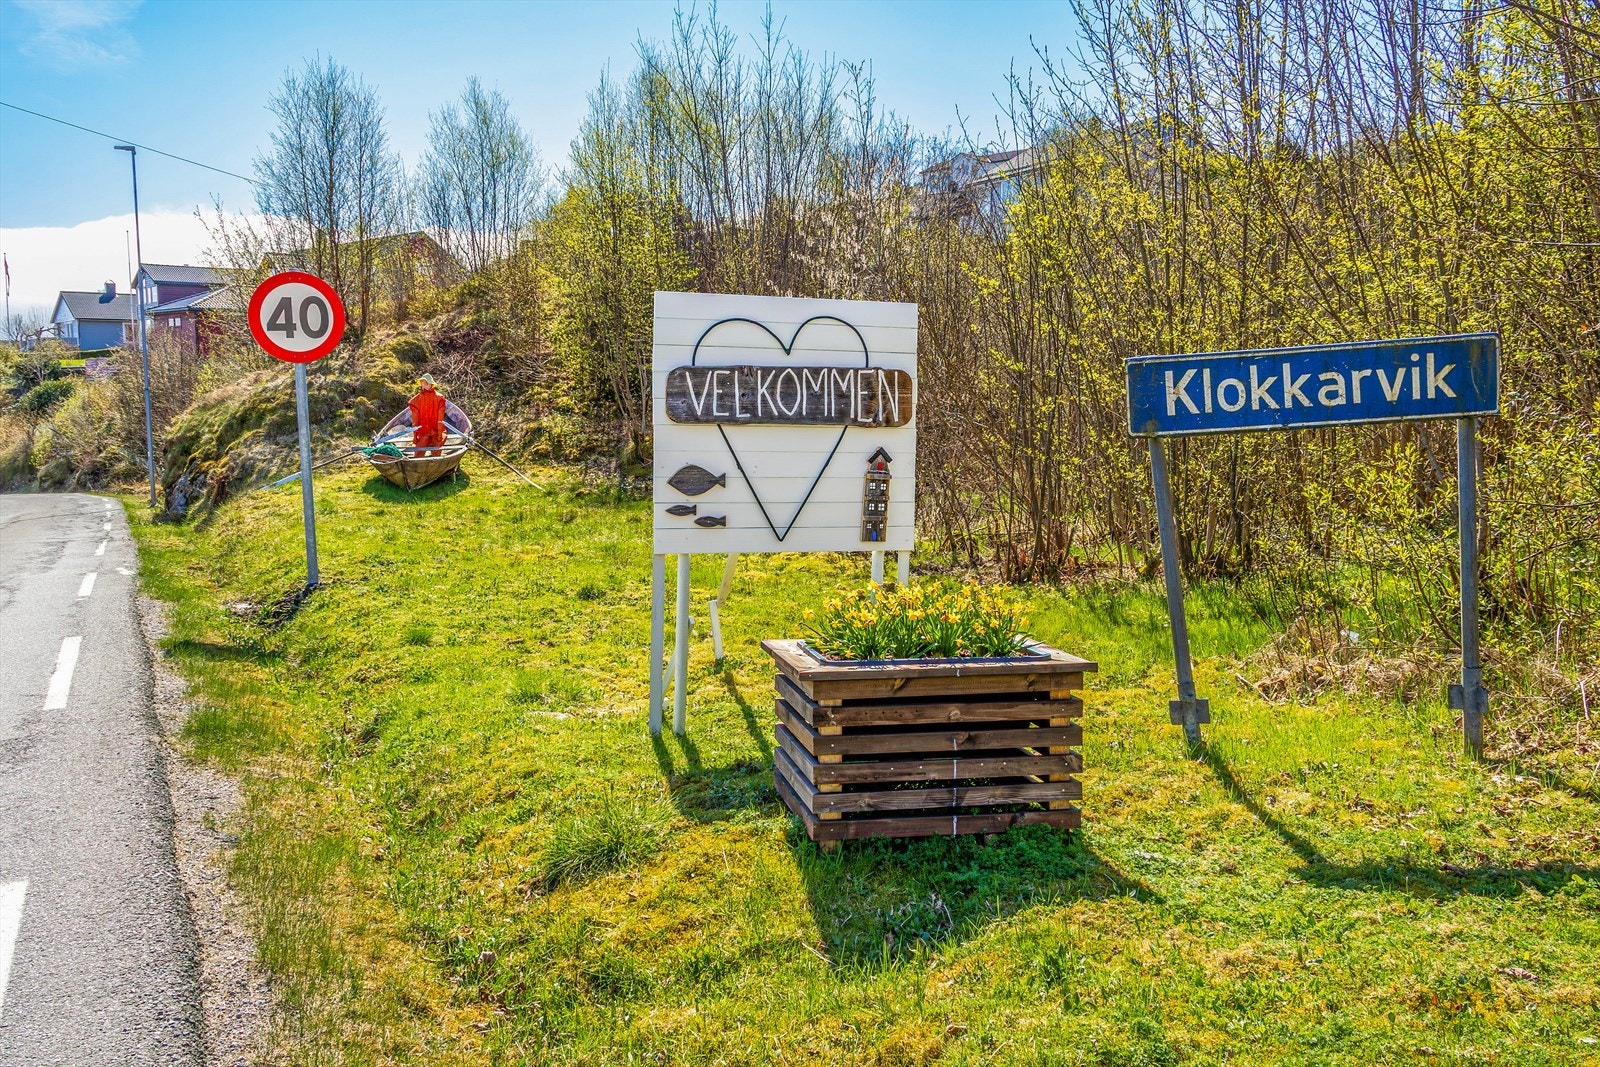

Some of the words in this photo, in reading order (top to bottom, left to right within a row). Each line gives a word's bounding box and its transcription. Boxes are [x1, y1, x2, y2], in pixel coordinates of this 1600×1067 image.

[266, 295, 329, 339] 40
[685, 368, 899, 423] VELKOMMEN
[1164, 352, 1457, 416] Klokkarvik
